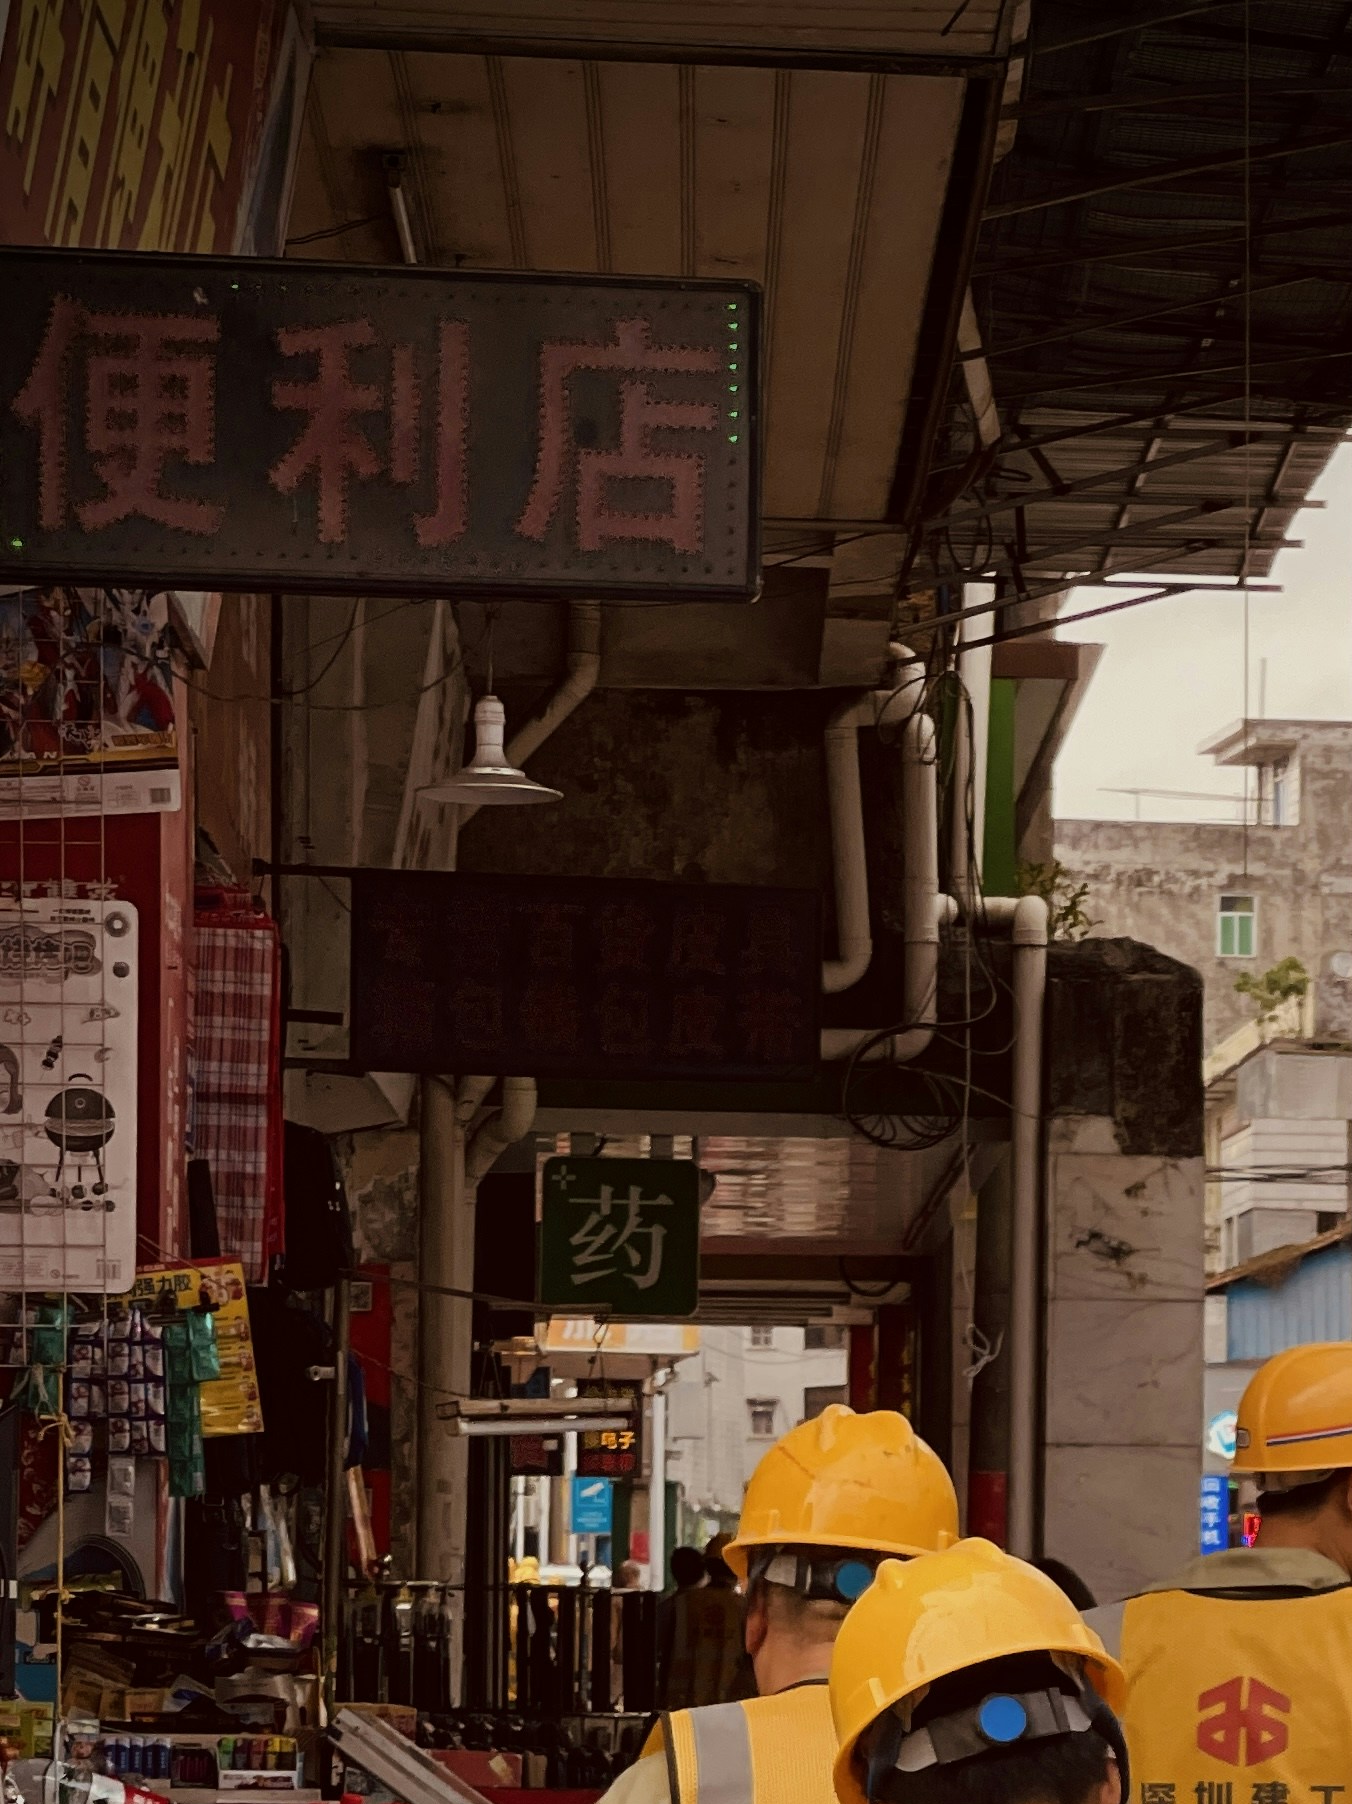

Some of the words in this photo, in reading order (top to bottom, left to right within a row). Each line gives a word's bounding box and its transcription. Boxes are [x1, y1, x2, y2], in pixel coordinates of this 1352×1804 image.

[11, 291, 723, 556] 便利店
[569, 1184, 674, 1291] 药
